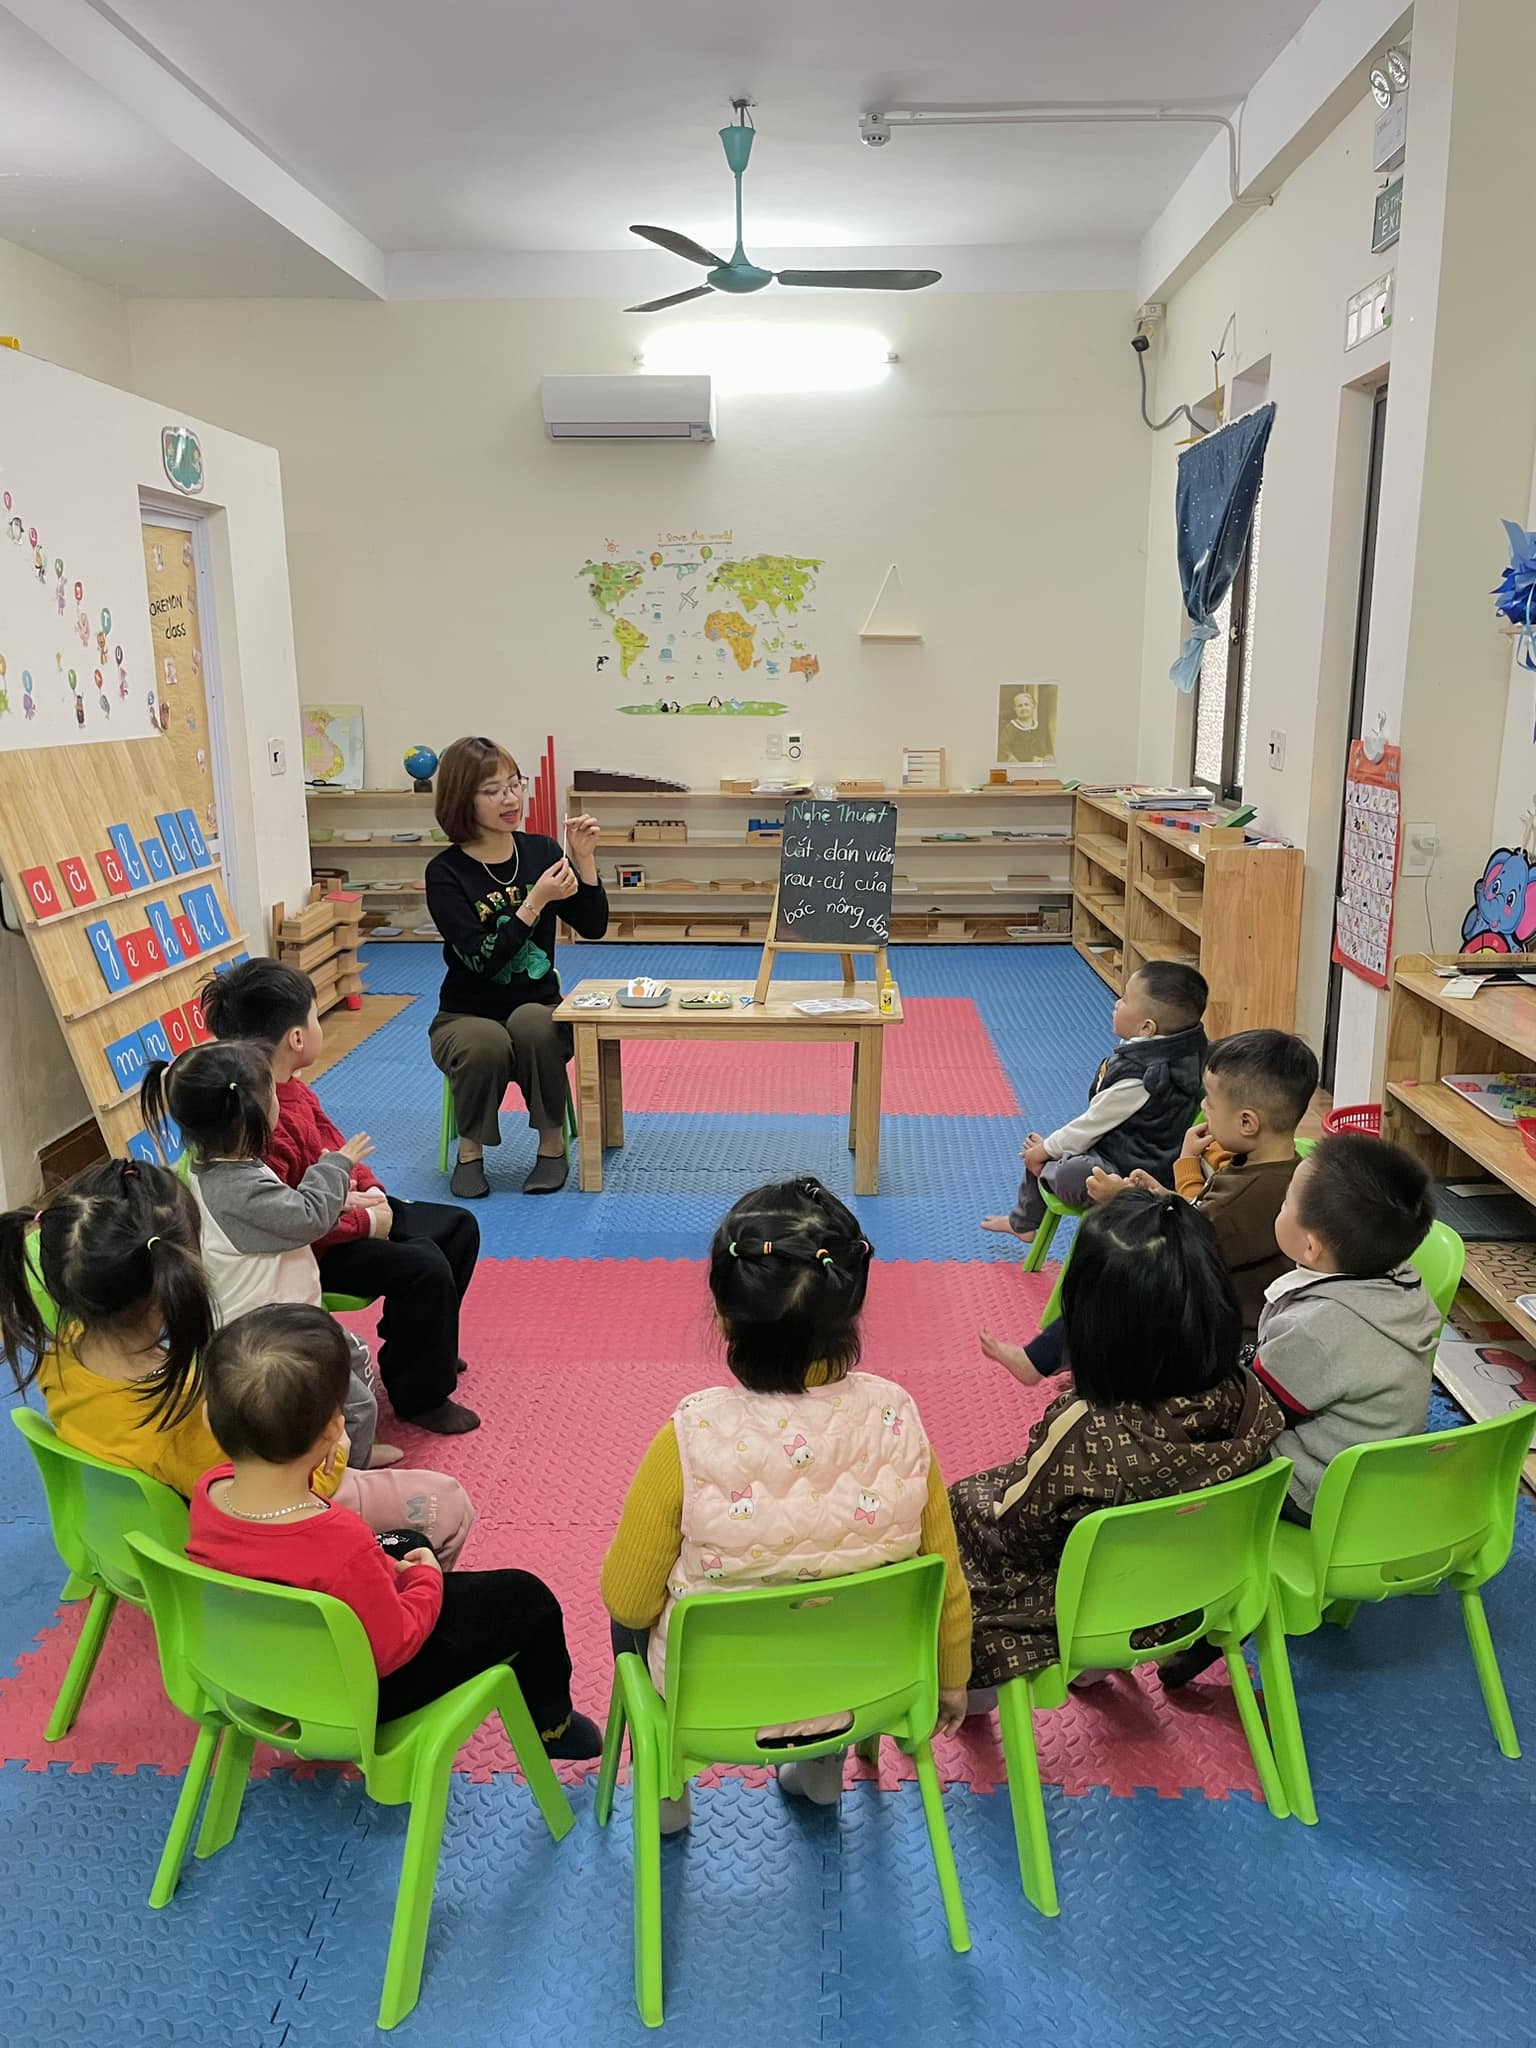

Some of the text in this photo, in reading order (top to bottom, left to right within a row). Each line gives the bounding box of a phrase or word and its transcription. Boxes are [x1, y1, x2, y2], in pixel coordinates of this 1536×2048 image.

[792, 800, 889, 829] Nghệ Thuật
[33, 880, 52, 904] a
[67, 864, 87, 893] ă
[106, 855, 123, 883] â
[118, 832, 140, 880] b
[151, 849, 163, 869] c
[169, 824, 186, 862] d
[823, 838, 859, 863] dán
[854, 871, 887, 893] của
[783, 899, 816, 925] bác
[826, 896, 865, 929] nông
[96, 929, 120, 980] g
[126, 940, 140, 967] ê
[147, 940, 159, 960] e
[154, 910, 179, 958] h
[180, 922, 192, 946] i
[188, 899, 211, 944] k
[116, 1046, 143, 1076] m
[147, 1033, 166, 1057] n
[172, 1021, 184, 1042] o
